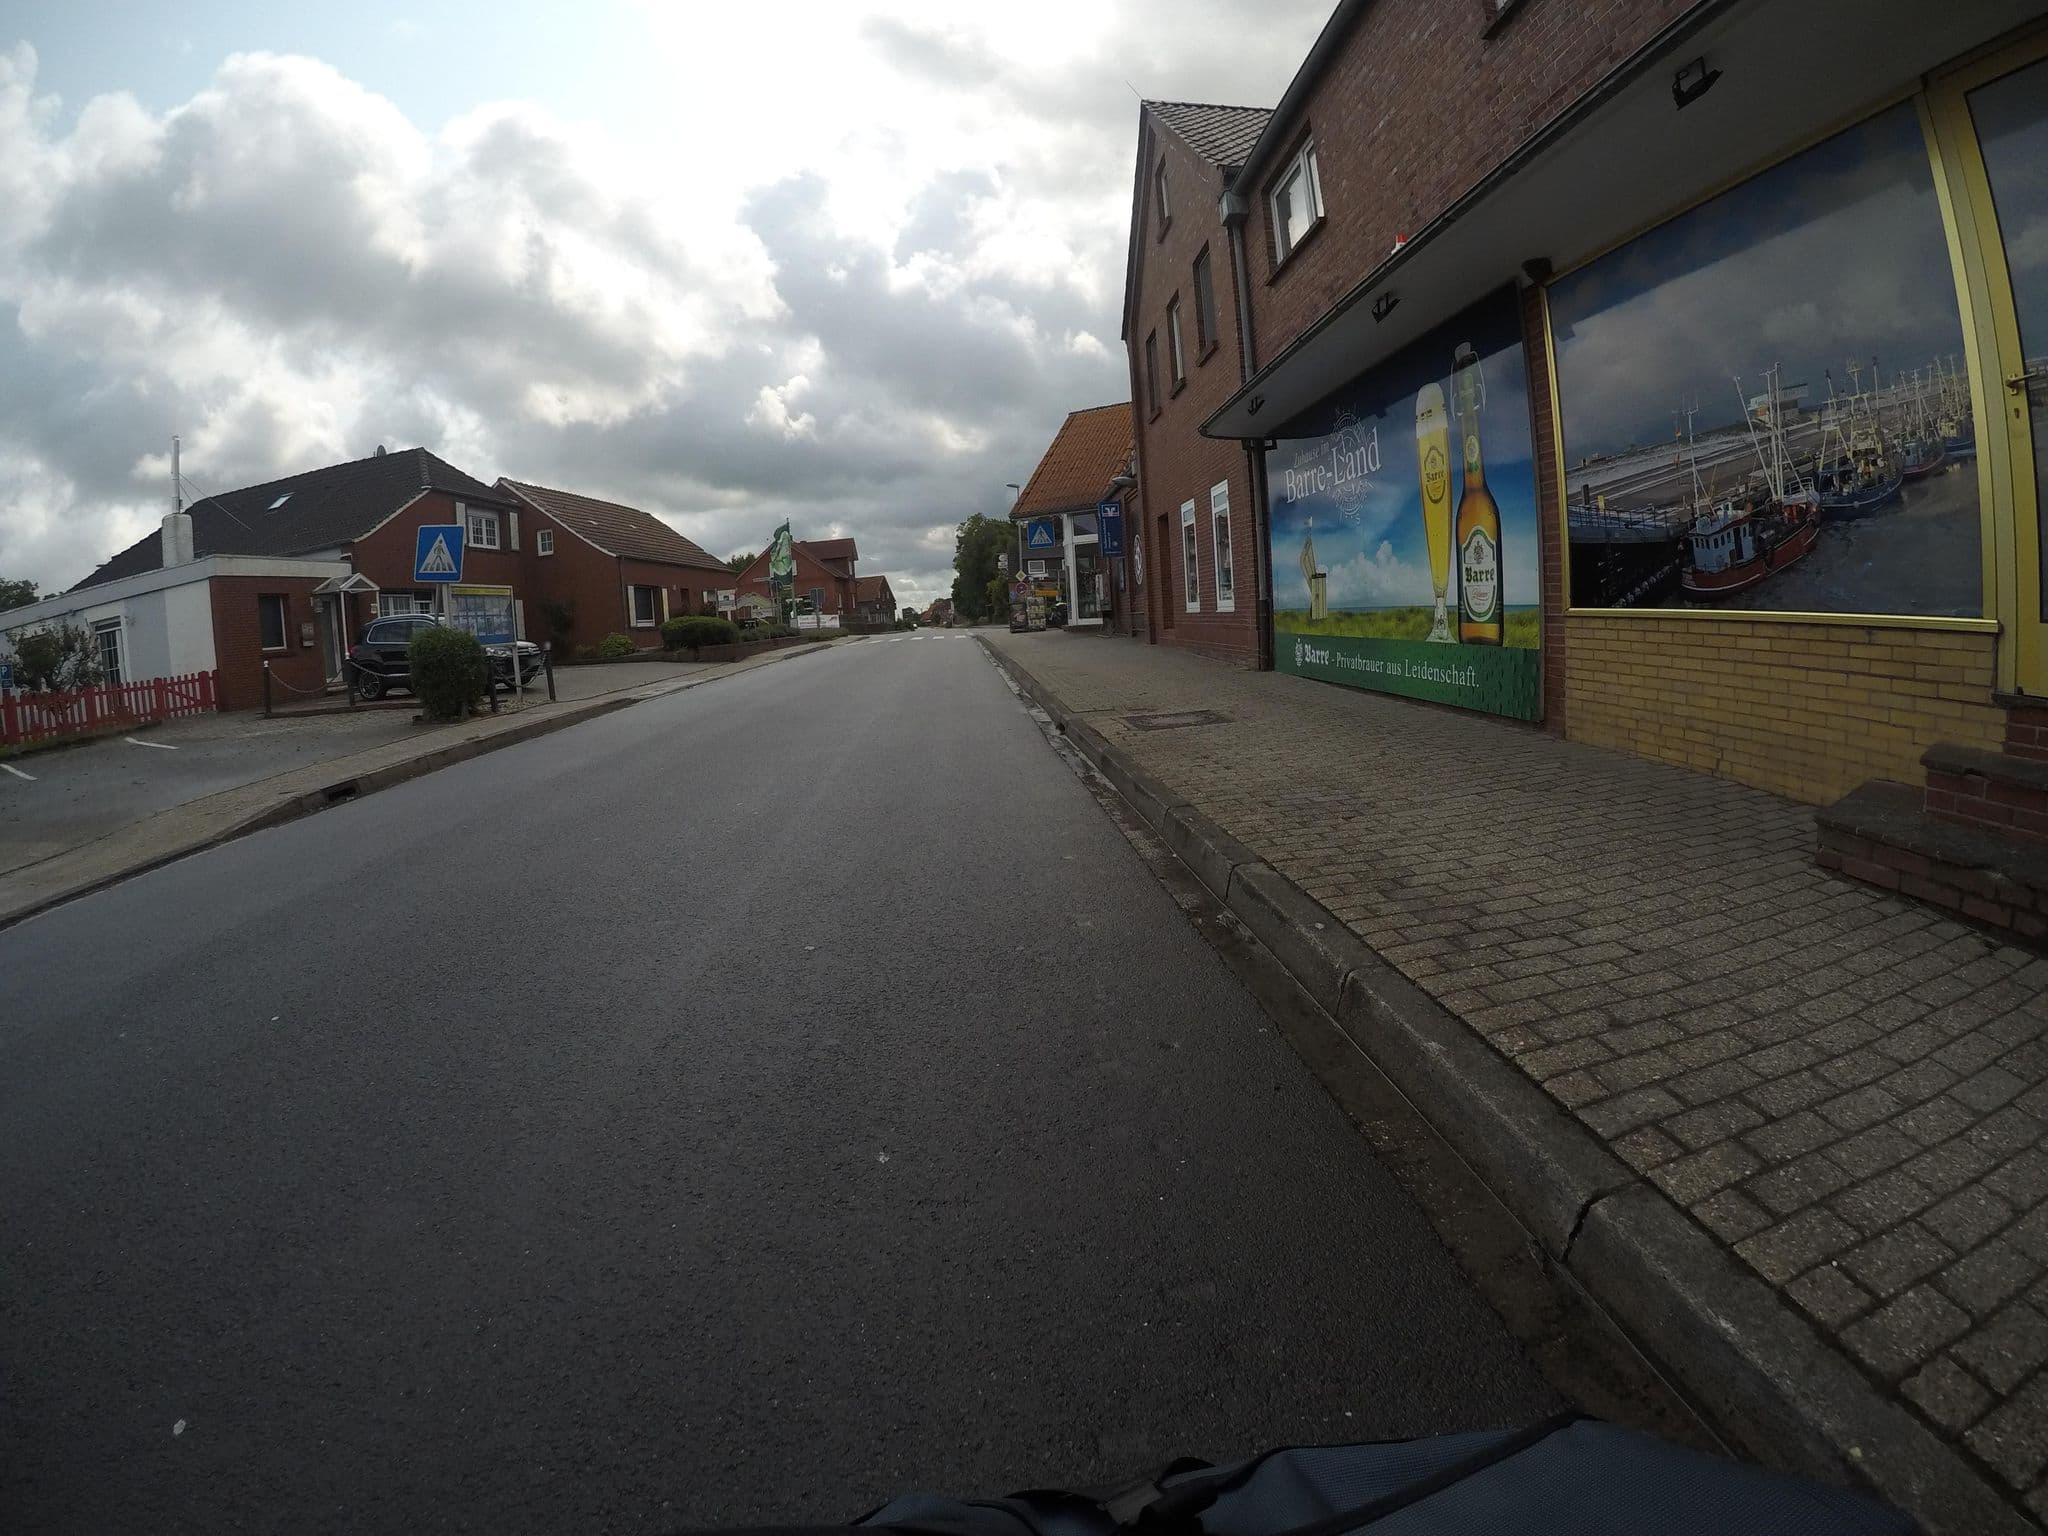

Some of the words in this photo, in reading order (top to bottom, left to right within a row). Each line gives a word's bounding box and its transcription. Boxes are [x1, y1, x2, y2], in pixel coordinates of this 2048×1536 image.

[1285, 426, 1382, 503] Barre-Land
[1464, 566, 1495, 583] Barre
[1, 666, 8, 676] P
[1304, 644, 1330, 666] Barre
[1336, 653, 1384, 673] Privatbrauer
[1386, 661, 1402, 676] aus
[1404, 659, 1480, 688] Leidenschaft.
